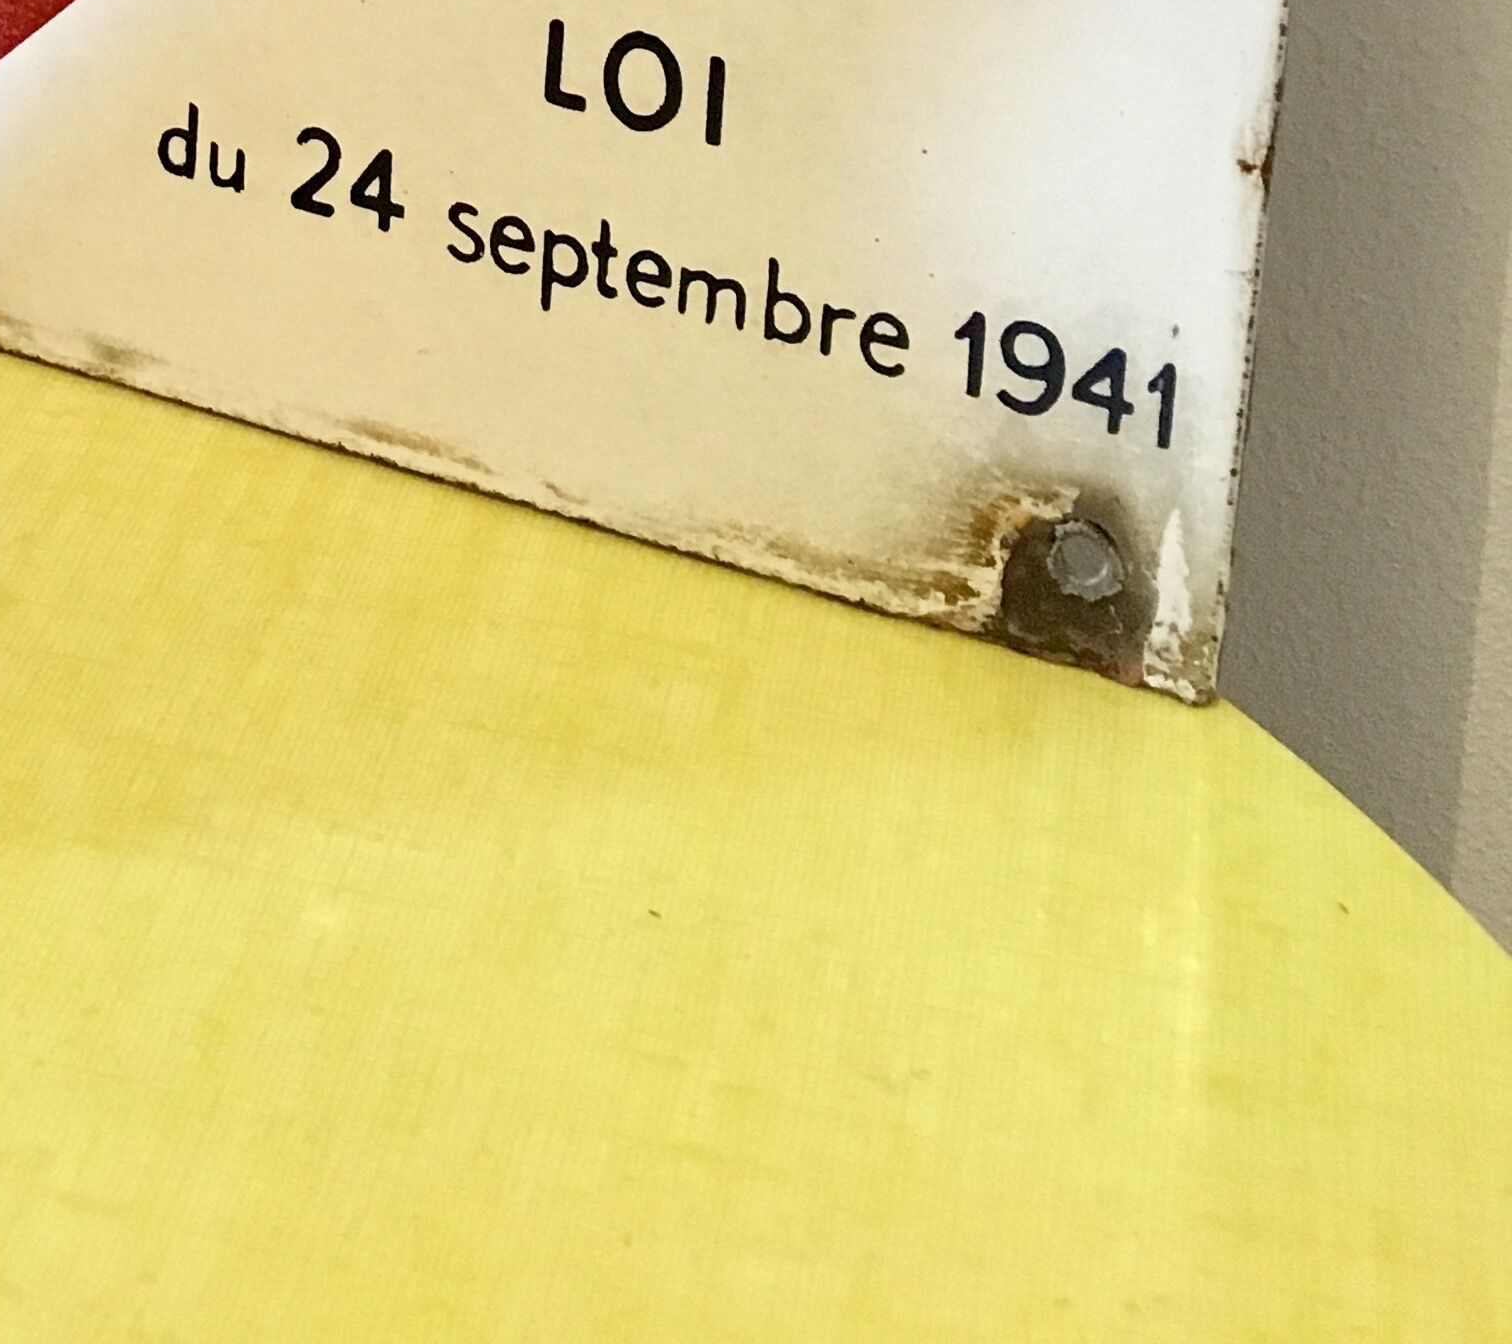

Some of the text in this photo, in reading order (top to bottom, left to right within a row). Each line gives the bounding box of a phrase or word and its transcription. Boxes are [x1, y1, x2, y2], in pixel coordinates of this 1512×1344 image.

[543, 18, 728, 147] LOI
[157, 102, 1180, 450] du 24 septembre 1941
